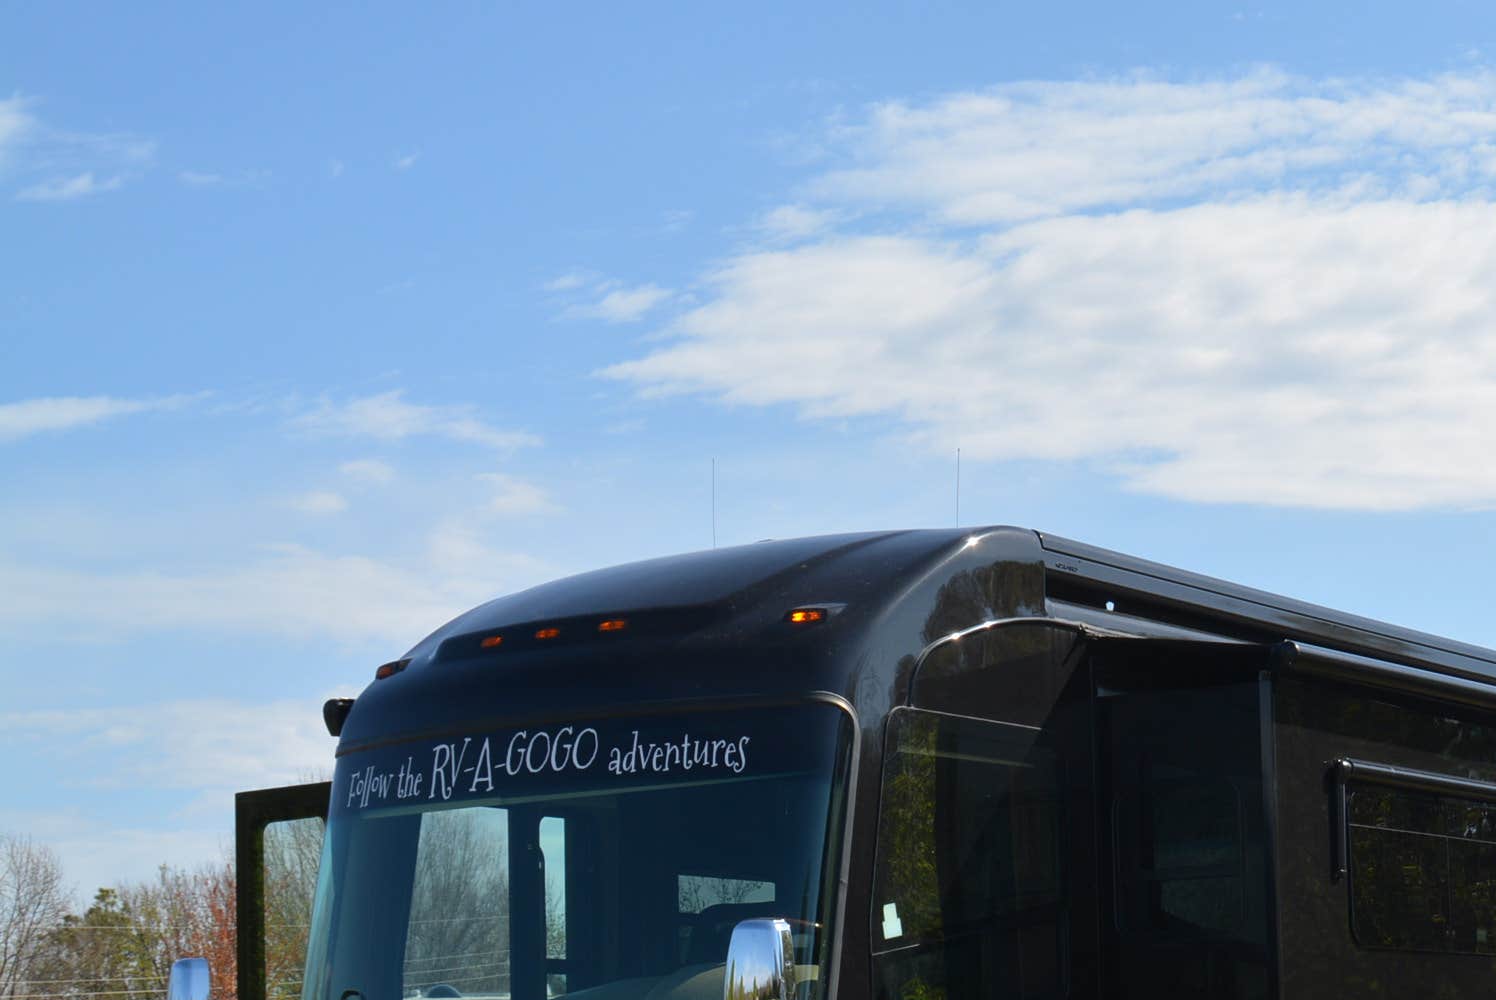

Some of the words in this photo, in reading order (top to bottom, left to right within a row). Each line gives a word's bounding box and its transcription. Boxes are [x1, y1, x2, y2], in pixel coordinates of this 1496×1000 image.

[347, 766, 394, 808] Follow
[397, 758, 423, 798] the
[428, 728, 599, 800] RV-A-GOGO
[608, 731, 750, 775] adventures
